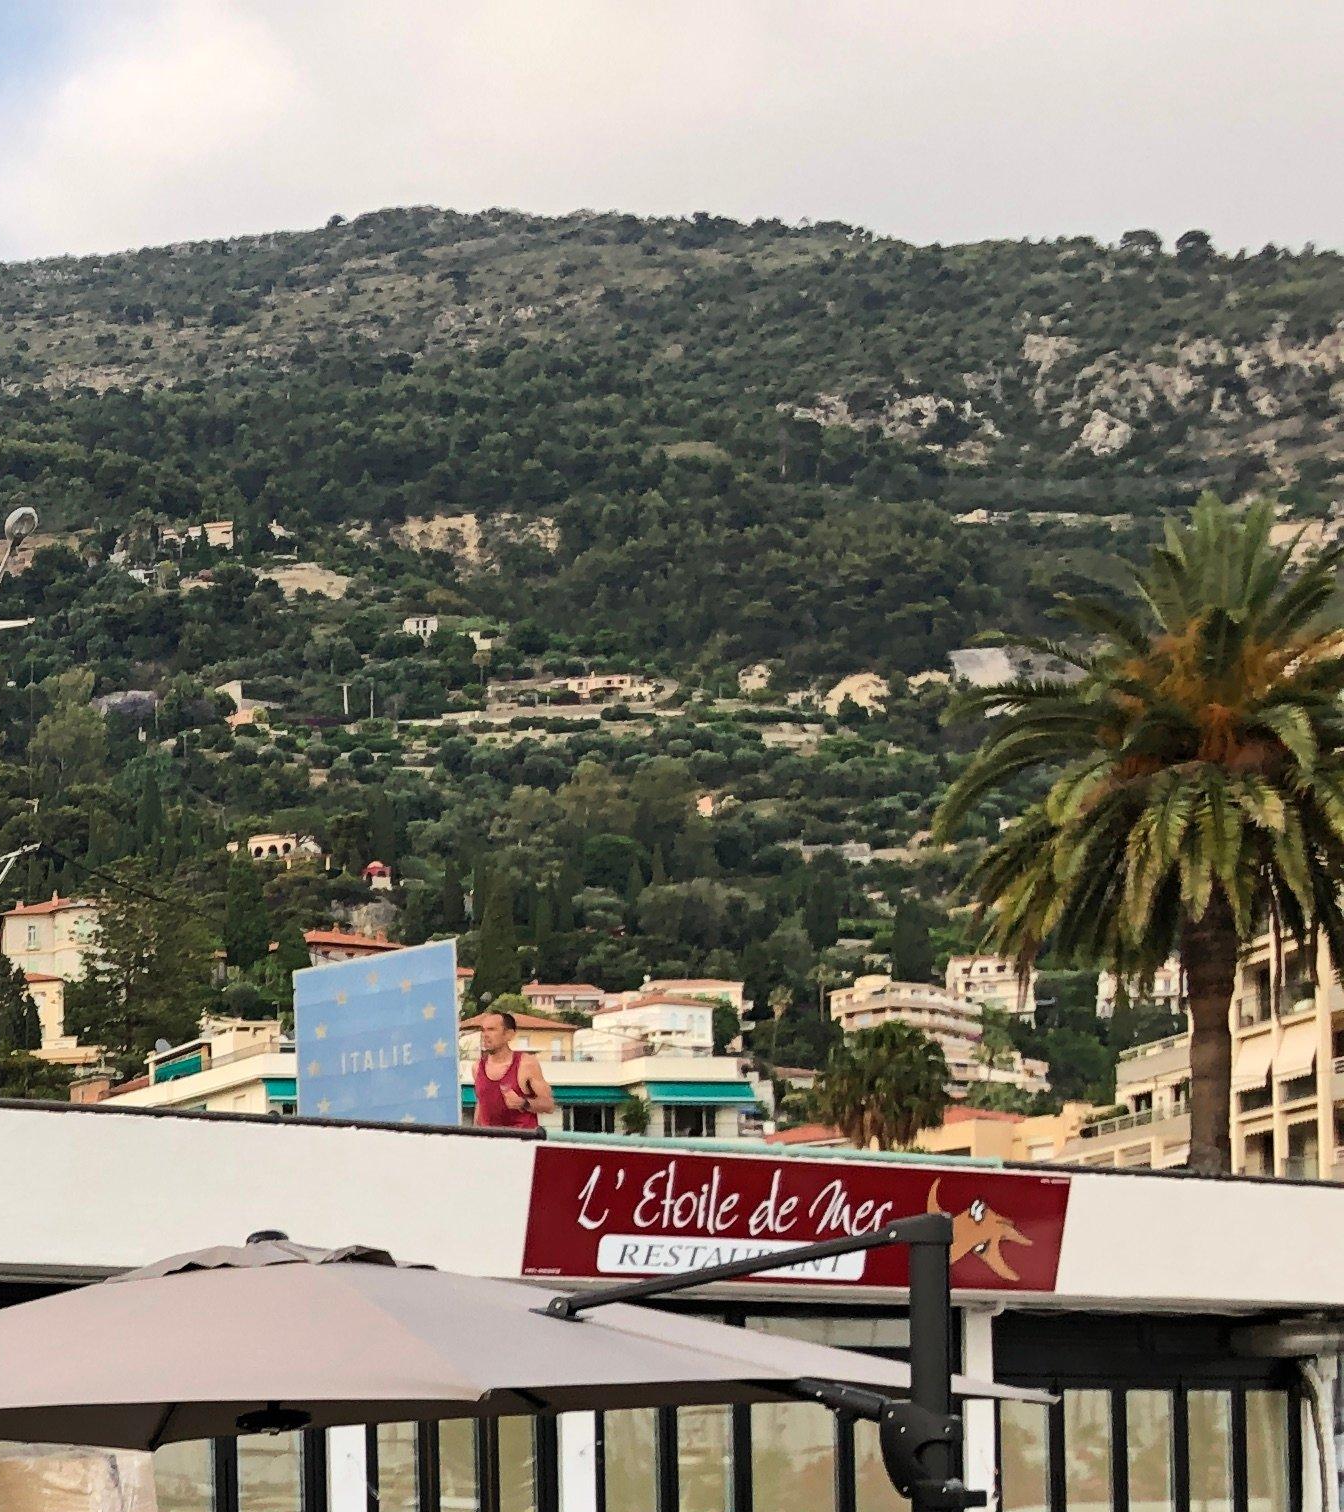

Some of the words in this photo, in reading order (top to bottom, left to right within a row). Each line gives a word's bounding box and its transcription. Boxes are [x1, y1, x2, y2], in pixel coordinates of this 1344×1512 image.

[340, 1042, 413, 1075] ITALIE
[748, 1168, 799, 1237] de
[808, 1178, 894, 1237] Mer
